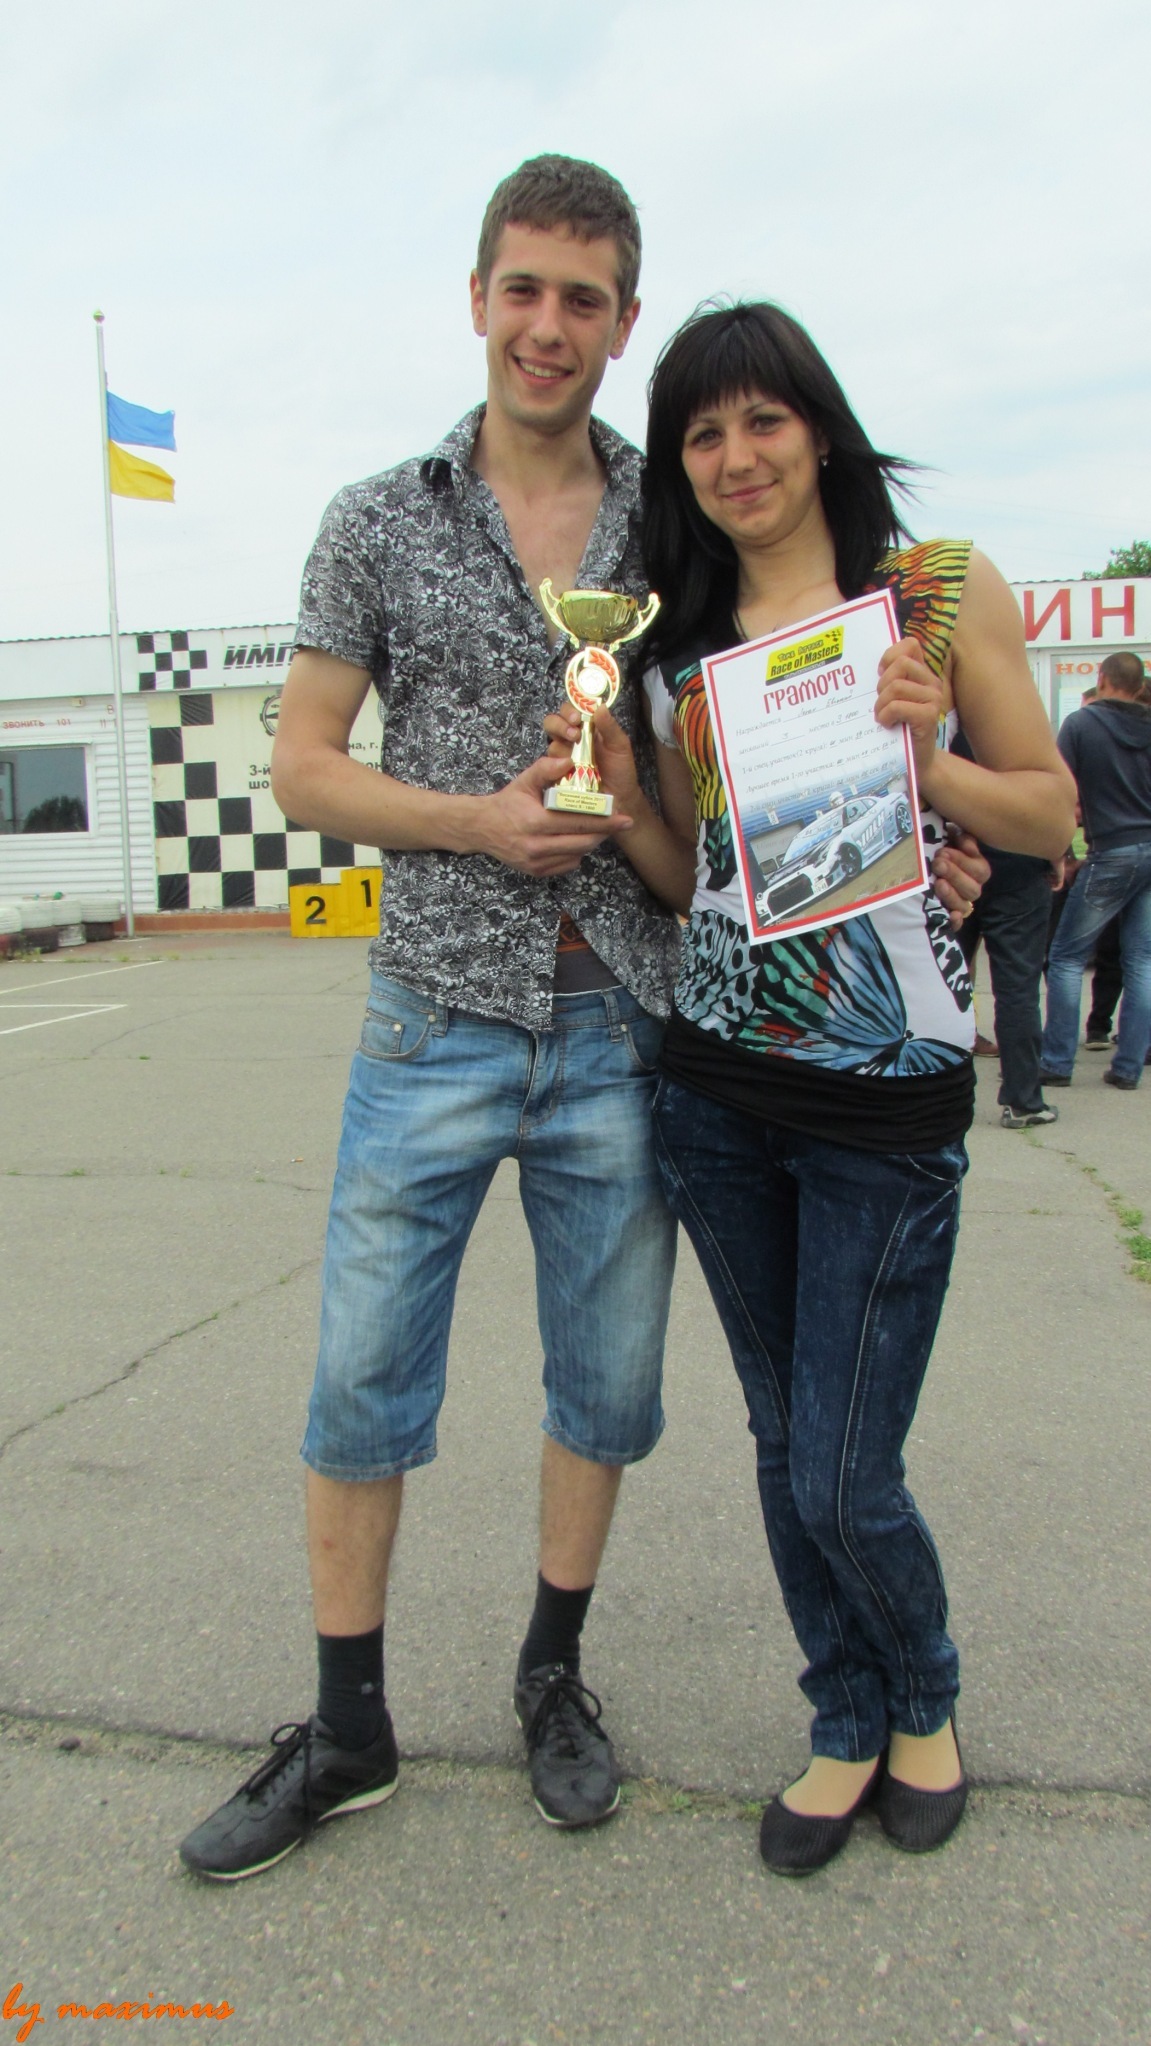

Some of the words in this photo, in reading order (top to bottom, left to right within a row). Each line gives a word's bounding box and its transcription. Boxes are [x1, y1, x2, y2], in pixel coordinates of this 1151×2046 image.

[770, 661, 792, 677] Race
[794, 655, 803, 668] of
[804, 643, 840, 664] Masters
[3, 719, 45, 730] ЗВОНИТЬ
[56, 718, 71, 727] 101
[304, 895, 327, 925] 2
[360, 879, 373, 908] 1
